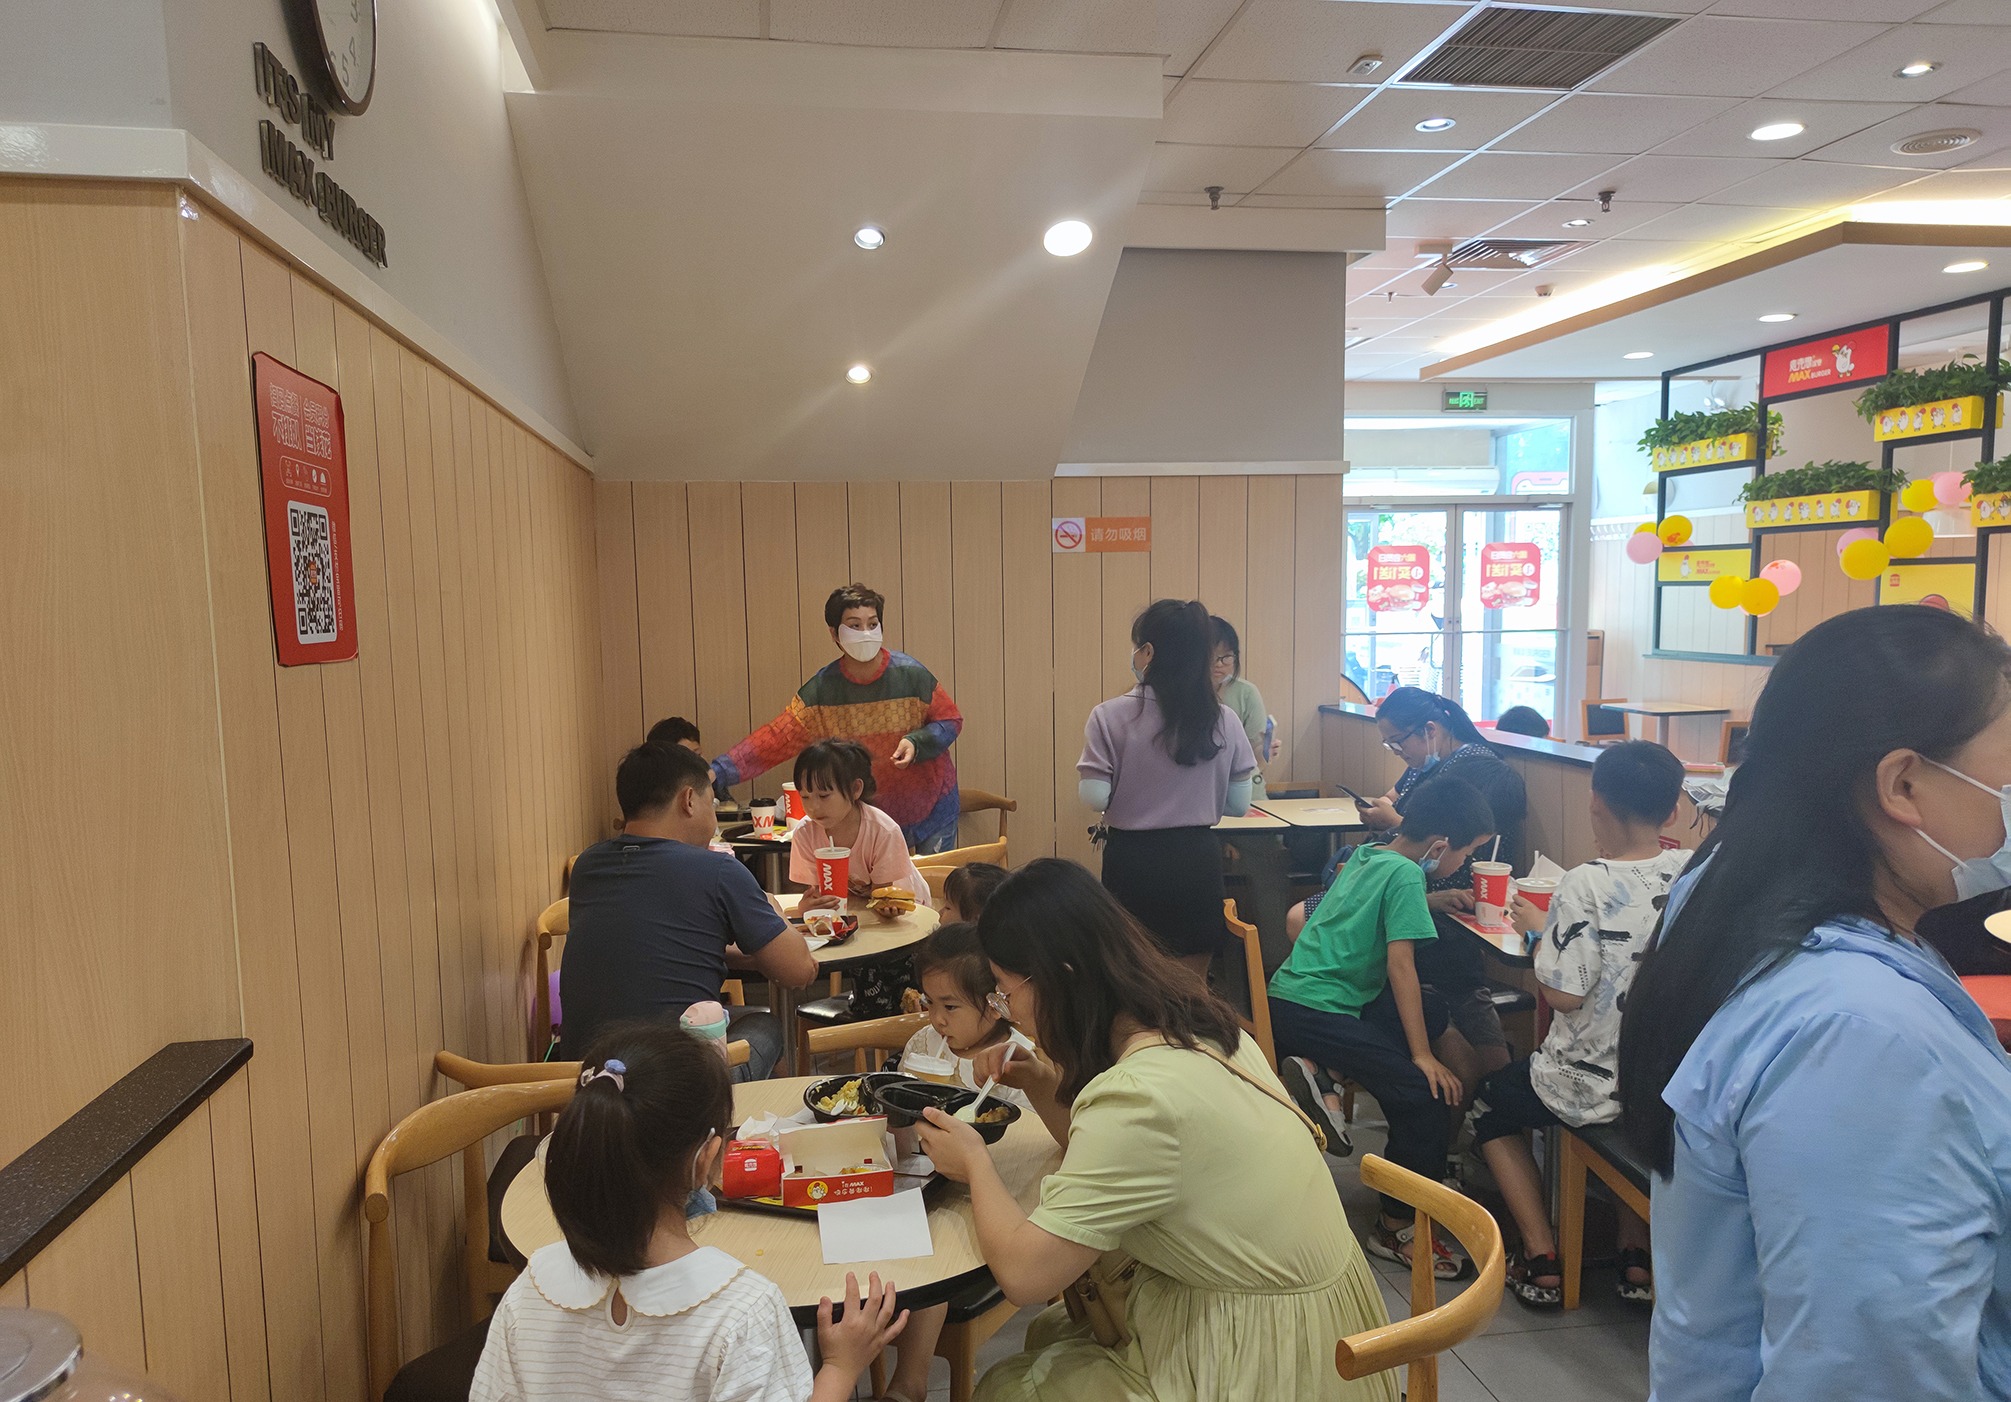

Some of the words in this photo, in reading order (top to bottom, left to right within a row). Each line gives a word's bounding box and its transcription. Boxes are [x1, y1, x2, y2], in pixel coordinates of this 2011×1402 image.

[1788, 369, 1811, 384] MAX
[1811, 369, 1831, 380] BURGER
[1091, 527, 1147, 542] 请勿吸烟
[784, 793, 792, 814] MAX
[822, 862, 833, 891] MAX
[1480, 877, 1488, 900] MAX
